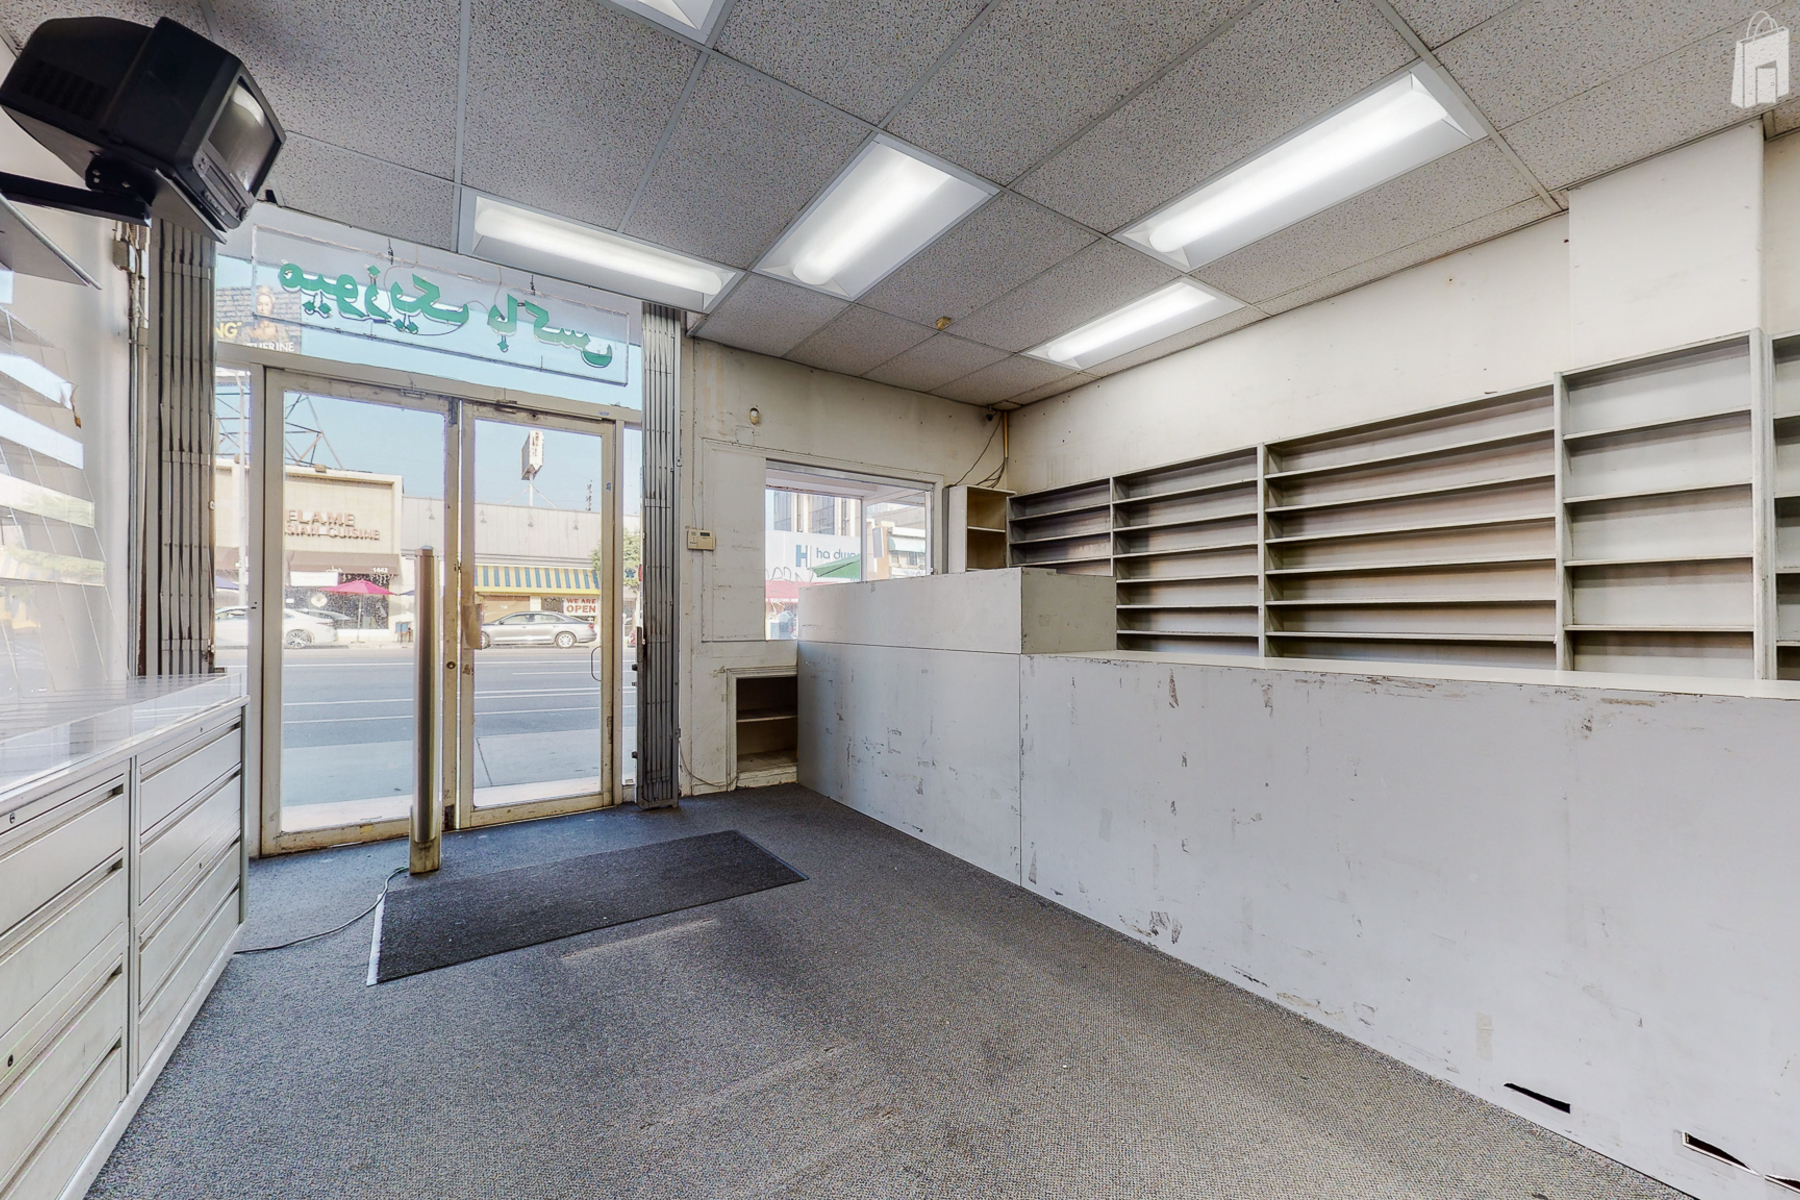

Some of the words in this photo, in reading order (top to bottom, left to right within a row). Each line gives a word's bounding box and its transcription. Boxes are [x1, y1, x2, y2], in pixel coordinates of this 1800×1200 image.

[285, 524, 320, 536] SIAN
[327, 527, 380, 541] CUISINE
[566, 604, 596, 613] OPEN
